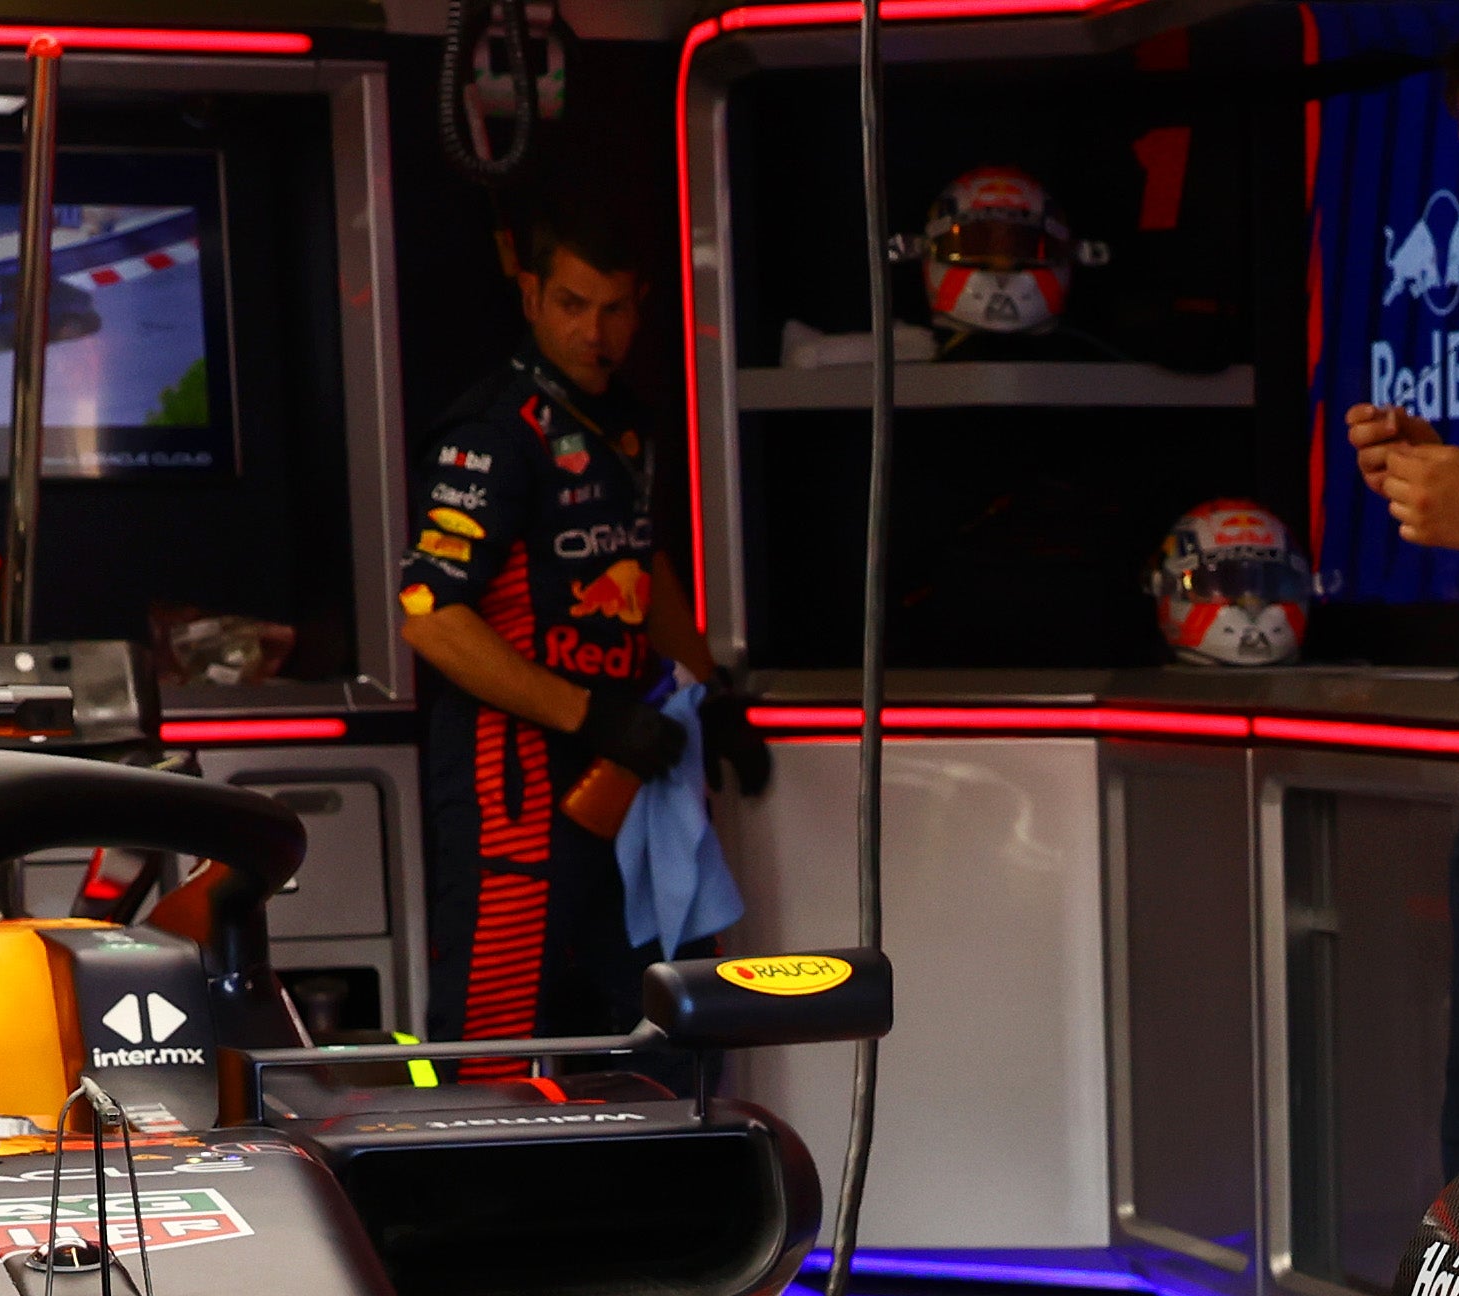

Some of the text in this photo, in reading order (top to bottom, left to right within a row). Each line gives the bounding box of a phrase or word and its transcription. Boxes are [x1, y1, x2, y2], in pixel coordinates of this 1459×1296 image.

[553, 517, 651, 559] ORAC
[544, 625, 634, 679] Red
[752, 960, 837, 979] RAUCH
[93, 1046, 205, 1068] inter.mx
